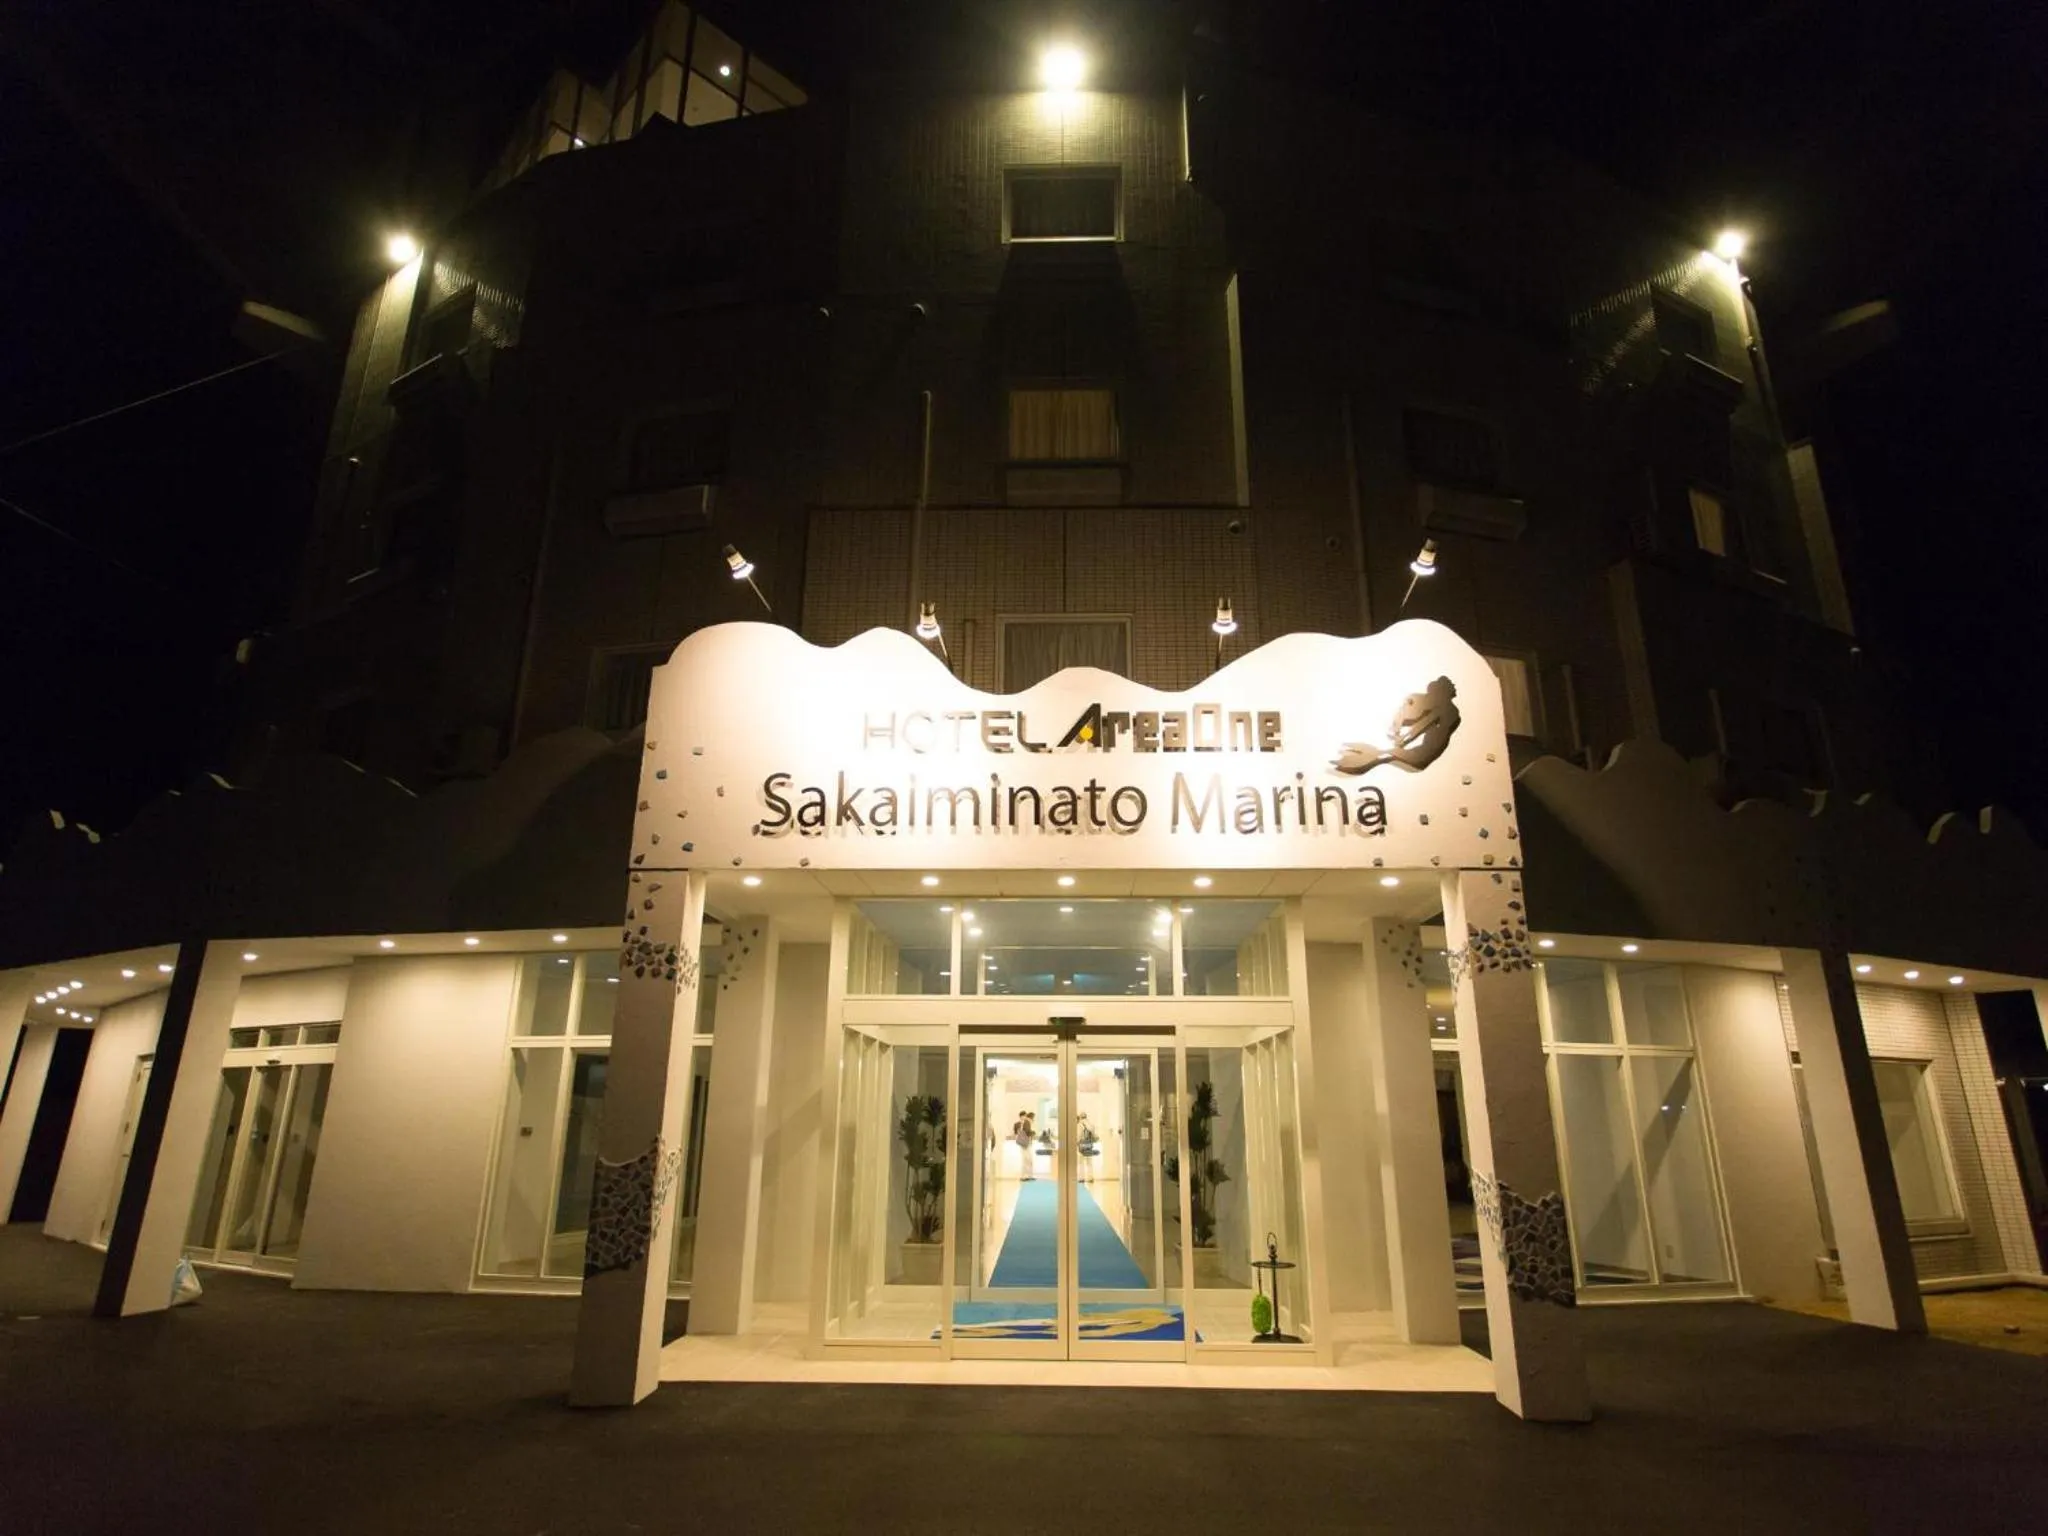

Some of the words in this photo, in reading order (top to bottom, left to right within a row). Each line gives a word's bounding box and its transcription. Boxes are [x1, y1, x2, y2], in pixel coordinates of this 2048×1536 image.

[862, 709, 1052, 753] HOTEL
[1056, 702, 1282, 753] AreaOne
[758, 770, 1148, 830] Sakaiminato
[1170, 771, 1389, 830] Marina
